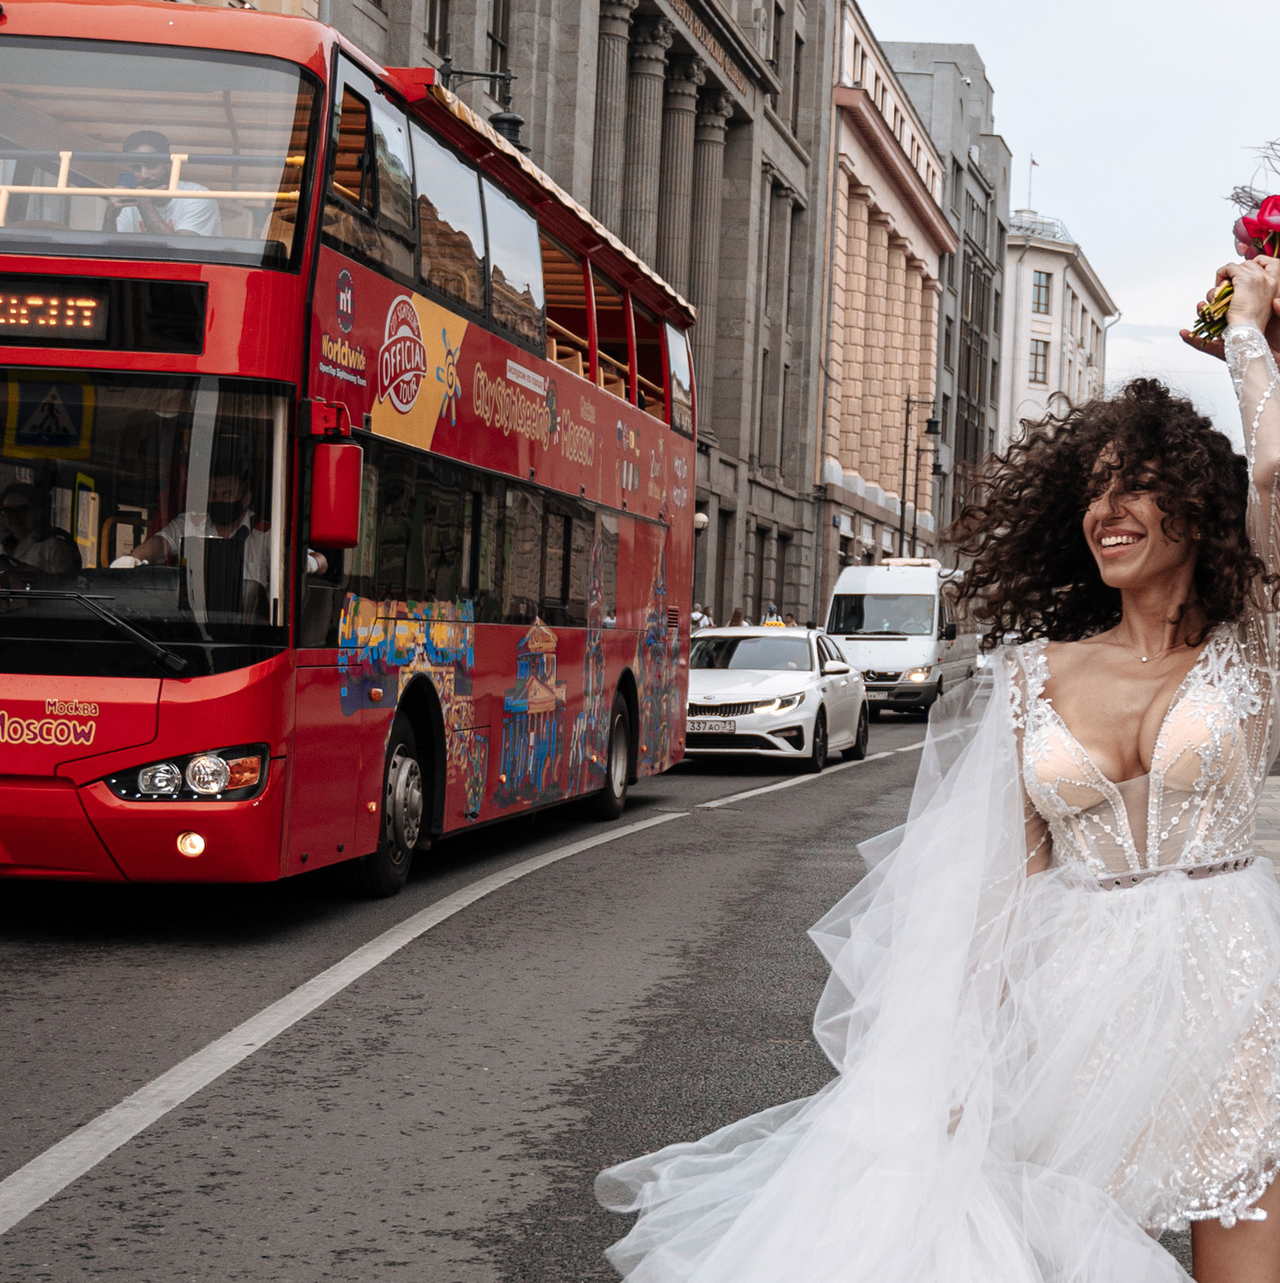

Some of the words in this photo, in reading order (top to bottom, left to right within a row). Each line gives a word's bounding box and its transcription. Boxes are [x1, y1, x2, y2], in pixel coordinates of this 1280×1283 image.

[382, 340, 426, 386] OFFICIAL
[399, 378, 417, 403] TOUR
[46, 698, 99, 716] Москва
